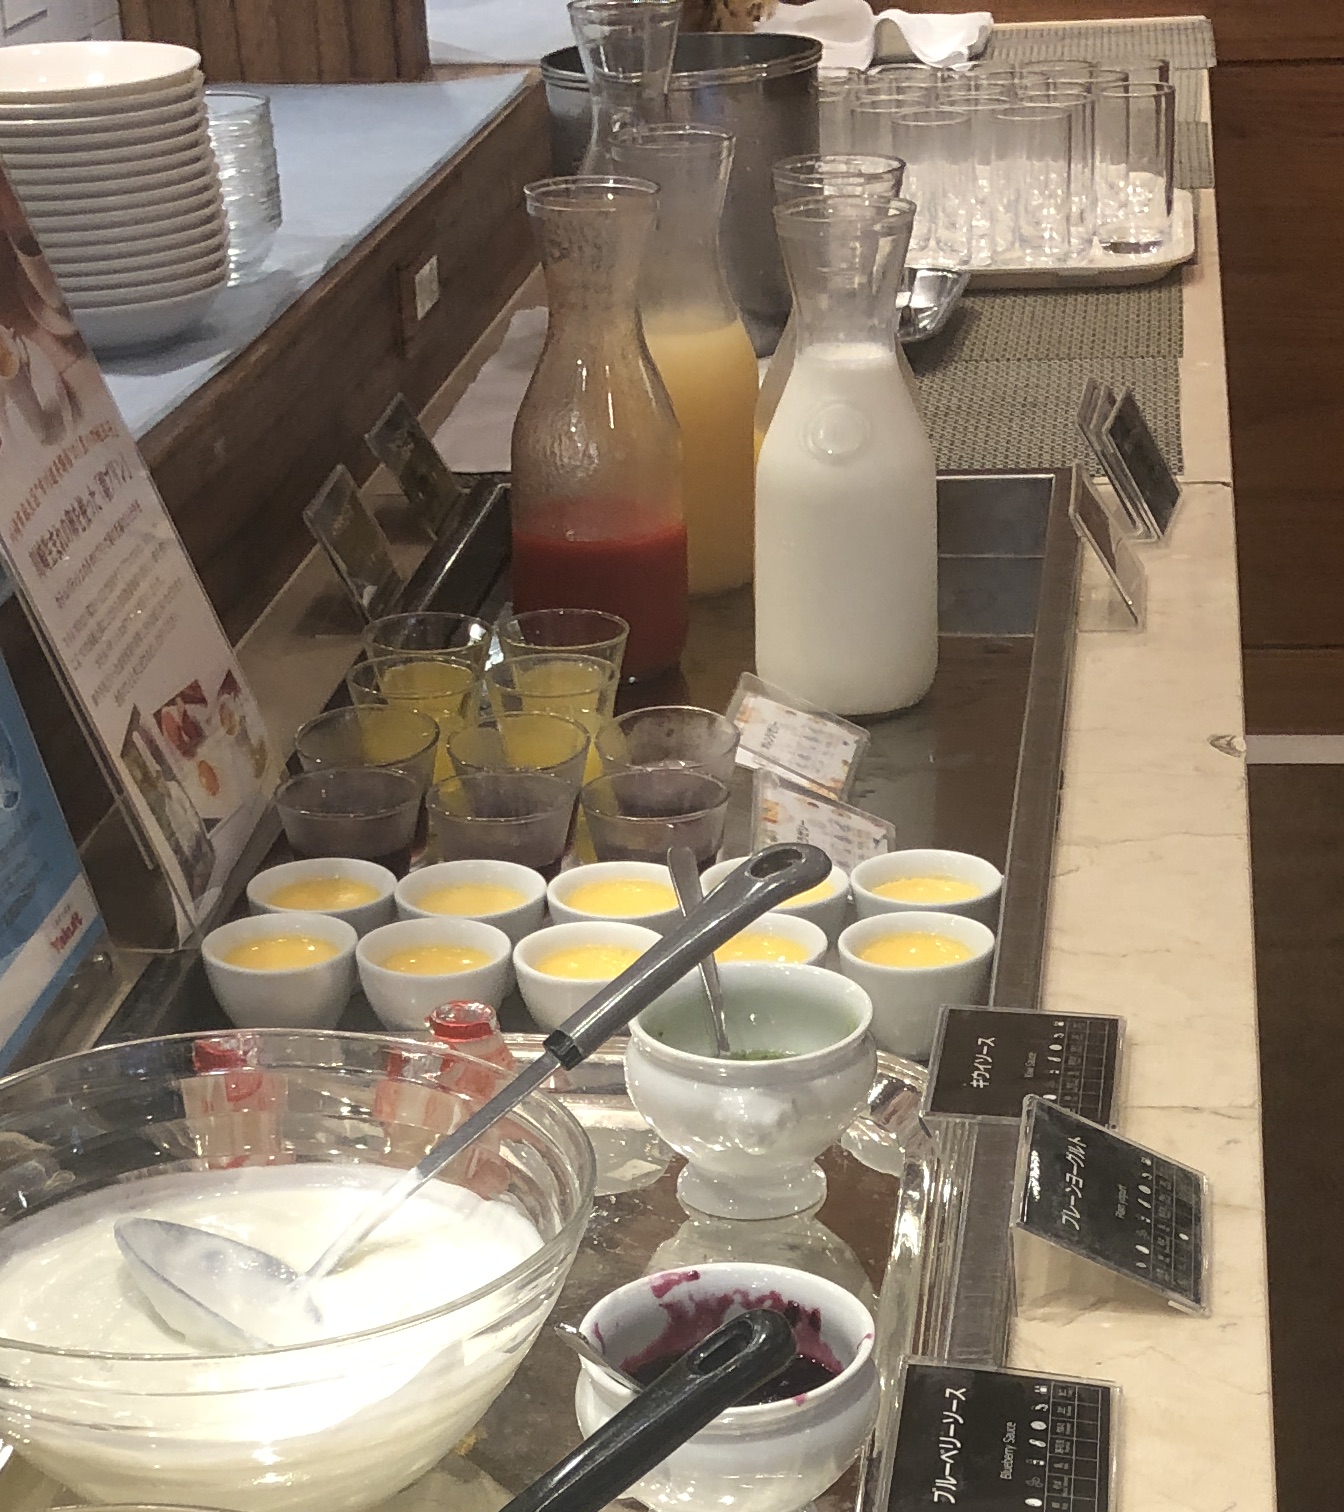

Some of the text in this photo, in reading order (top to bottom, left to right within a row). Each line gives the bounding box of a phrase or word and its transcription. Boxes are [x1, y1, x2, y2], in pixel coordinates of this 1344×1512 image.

[969, 1036, 997, 1089] キウイソース
[1060, 1135, 1087, 1231] プレーンヨーグルト
[930, 1386, 967, 1505] ブルーベリーソース
[999, 1420, 1017, 1480] Blueberry Sauce
